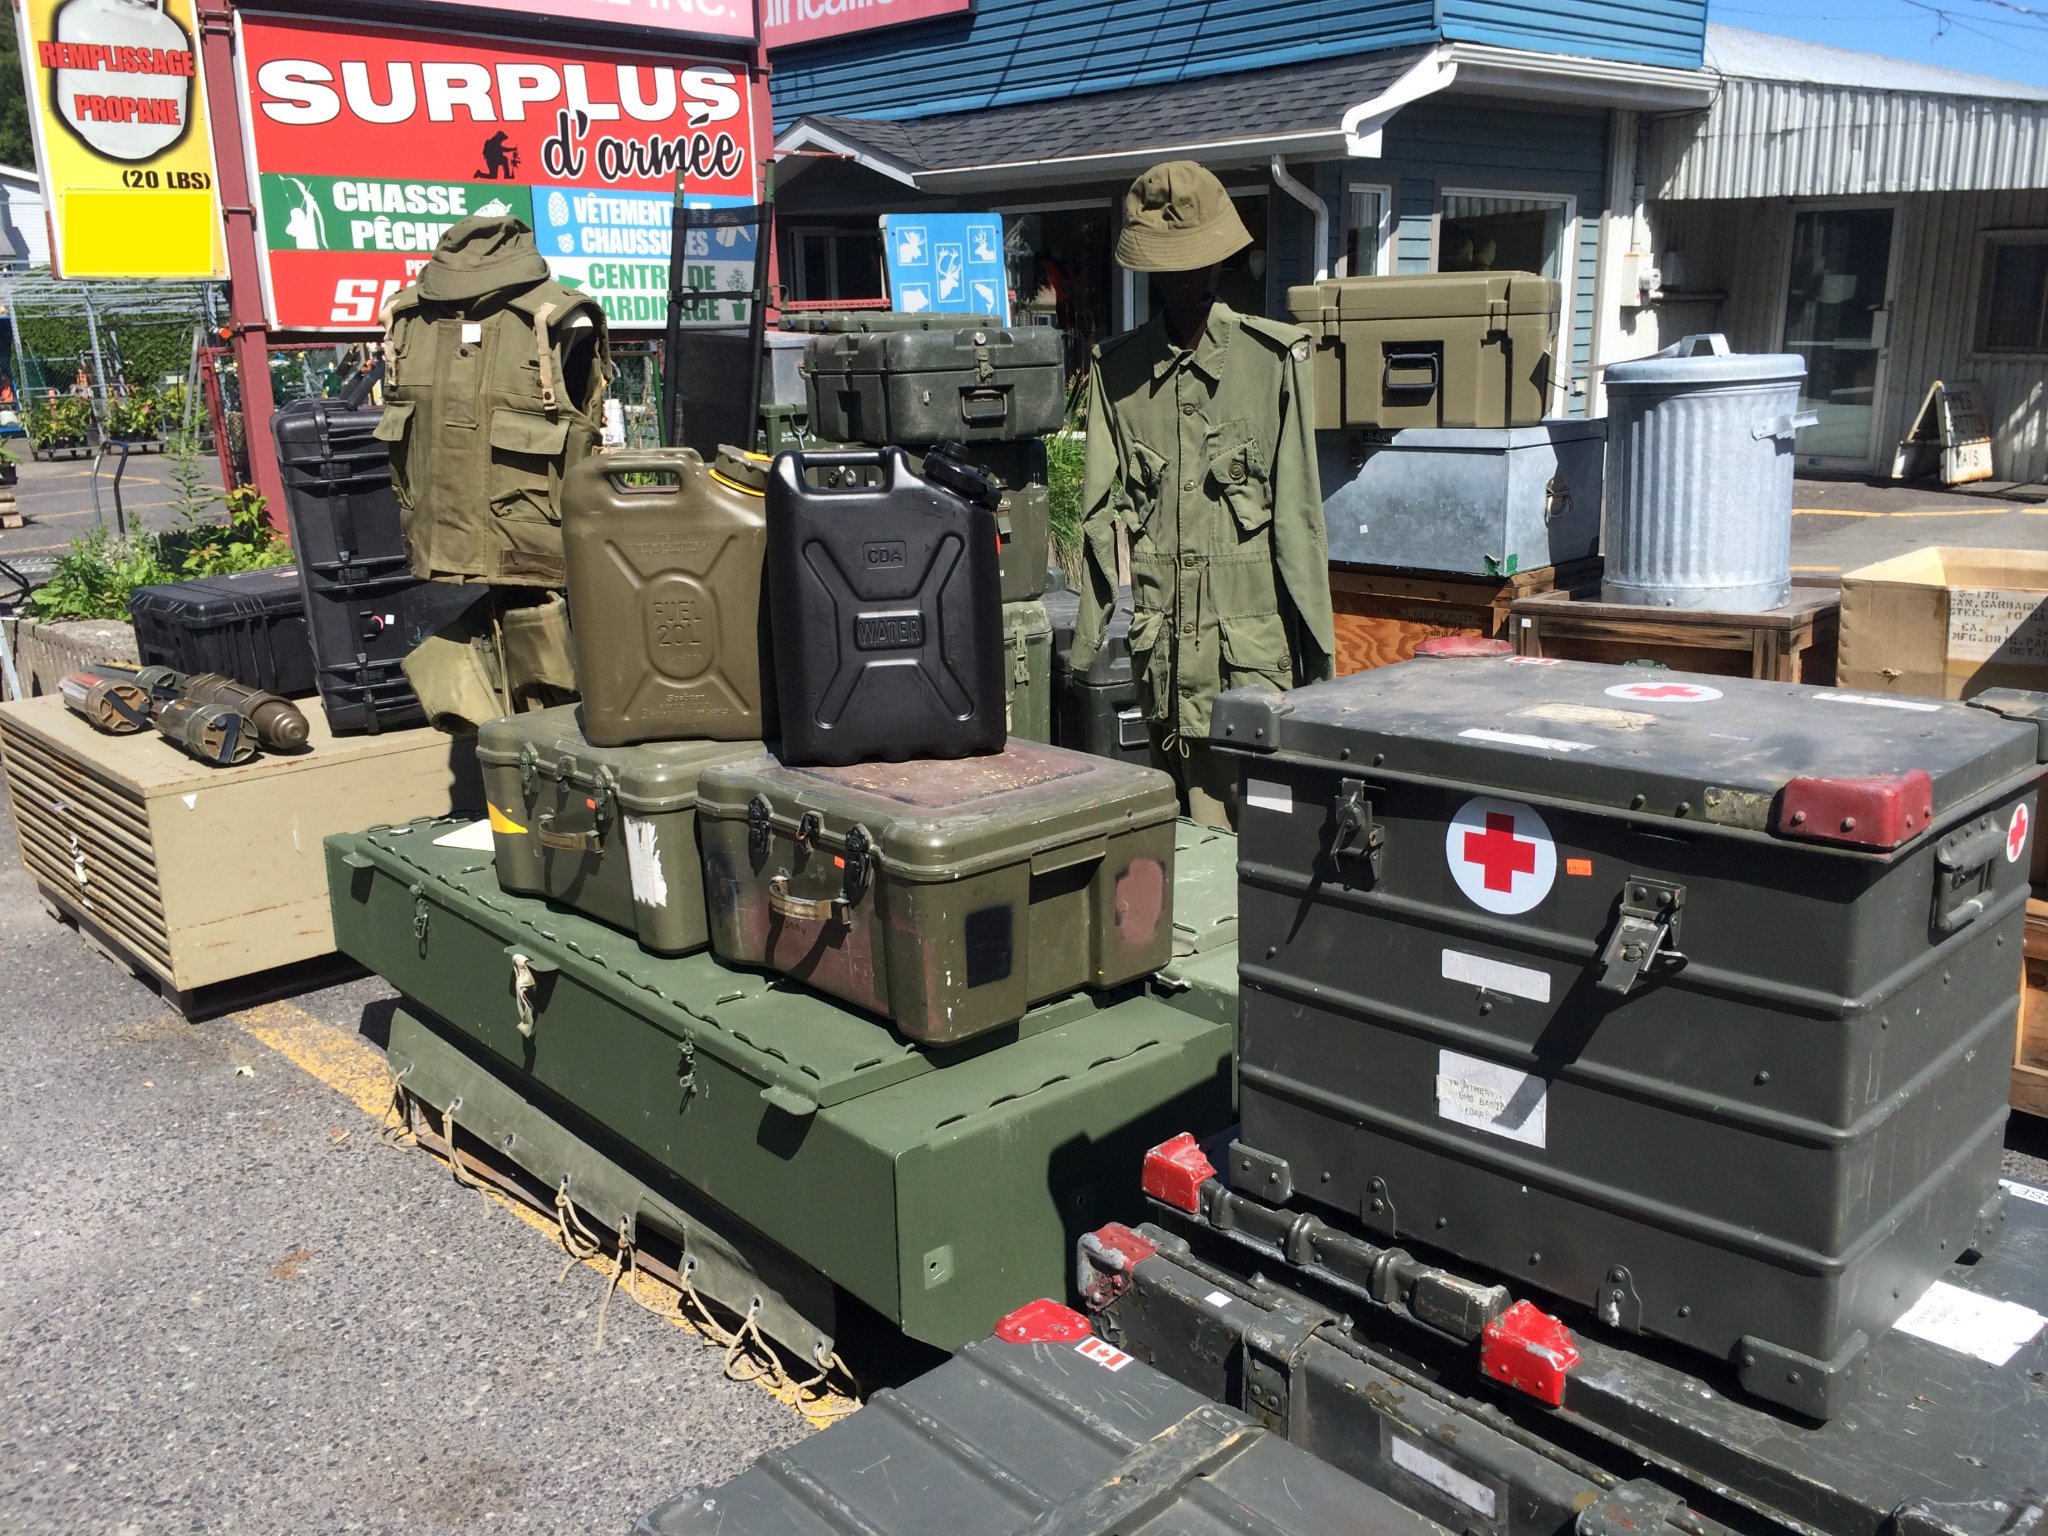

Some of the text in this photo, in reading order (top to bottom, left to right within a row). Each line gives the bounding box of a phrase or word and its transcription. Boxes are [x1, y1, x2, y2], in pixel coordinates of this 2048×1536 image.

[38, 41, 196, 77] REMPLISSAGE
[257, 58, 741, 125] SURPLUS
[74, 94, 181, 125] PROPANE
[544, 109, 743, 178] d'armée
[122, 170, 211, 189] (20 LBS)
[332, 181, 468, 215] CHASSE
[573, 192, 674, 227] VÊTEMENT
[581, 227, 709, 257] CHAUSSUES
[588, 263, 717, 290] CENTR DE
[868, 547, 902, 563] CDA
[652, 600, 703, 624] FUEL
[656, 624, 702, 647] 20L
[858, 619, 921, 644] WATER
